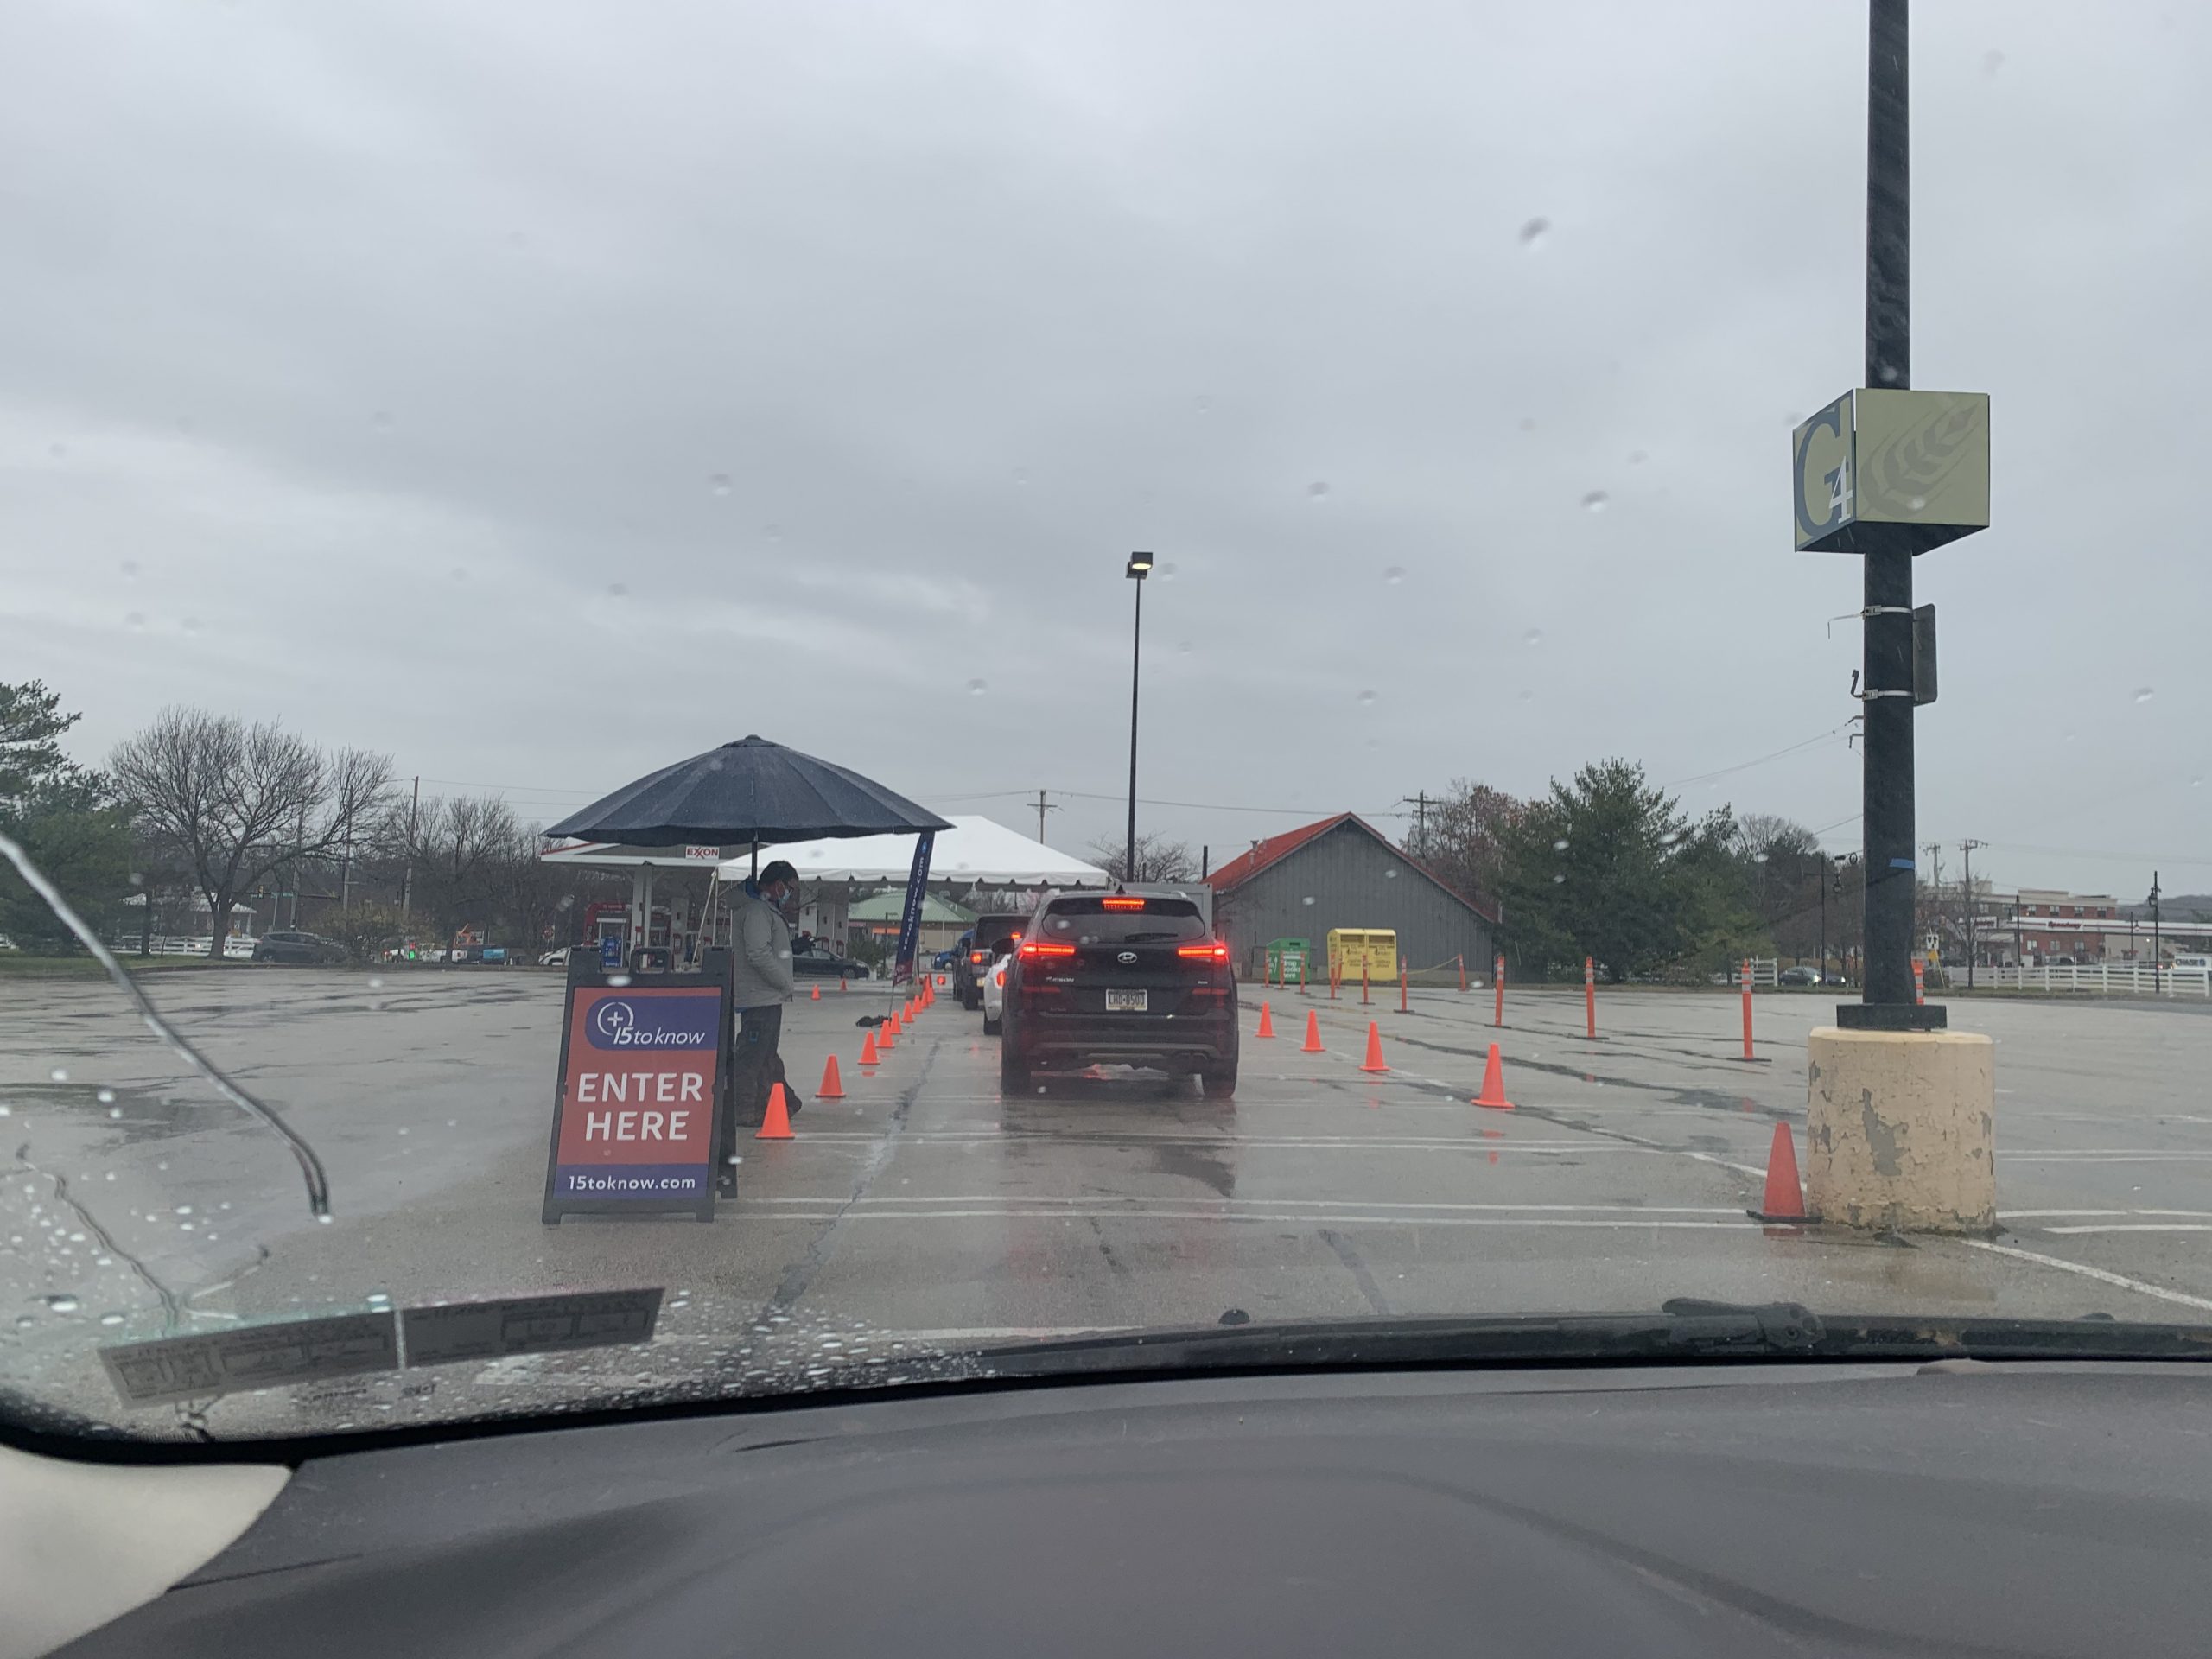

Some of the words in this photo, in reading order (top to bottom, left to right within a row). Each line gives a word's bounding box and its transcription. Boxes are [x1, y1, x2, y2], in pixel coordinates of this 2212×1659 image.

[687, 847, 718, 859] EXXON
[577, 1072, 703, 1103] ENTER
[585, 1110, 690, 1141] HERE
[569, 1175, 696, 1190] 15toknow.com
